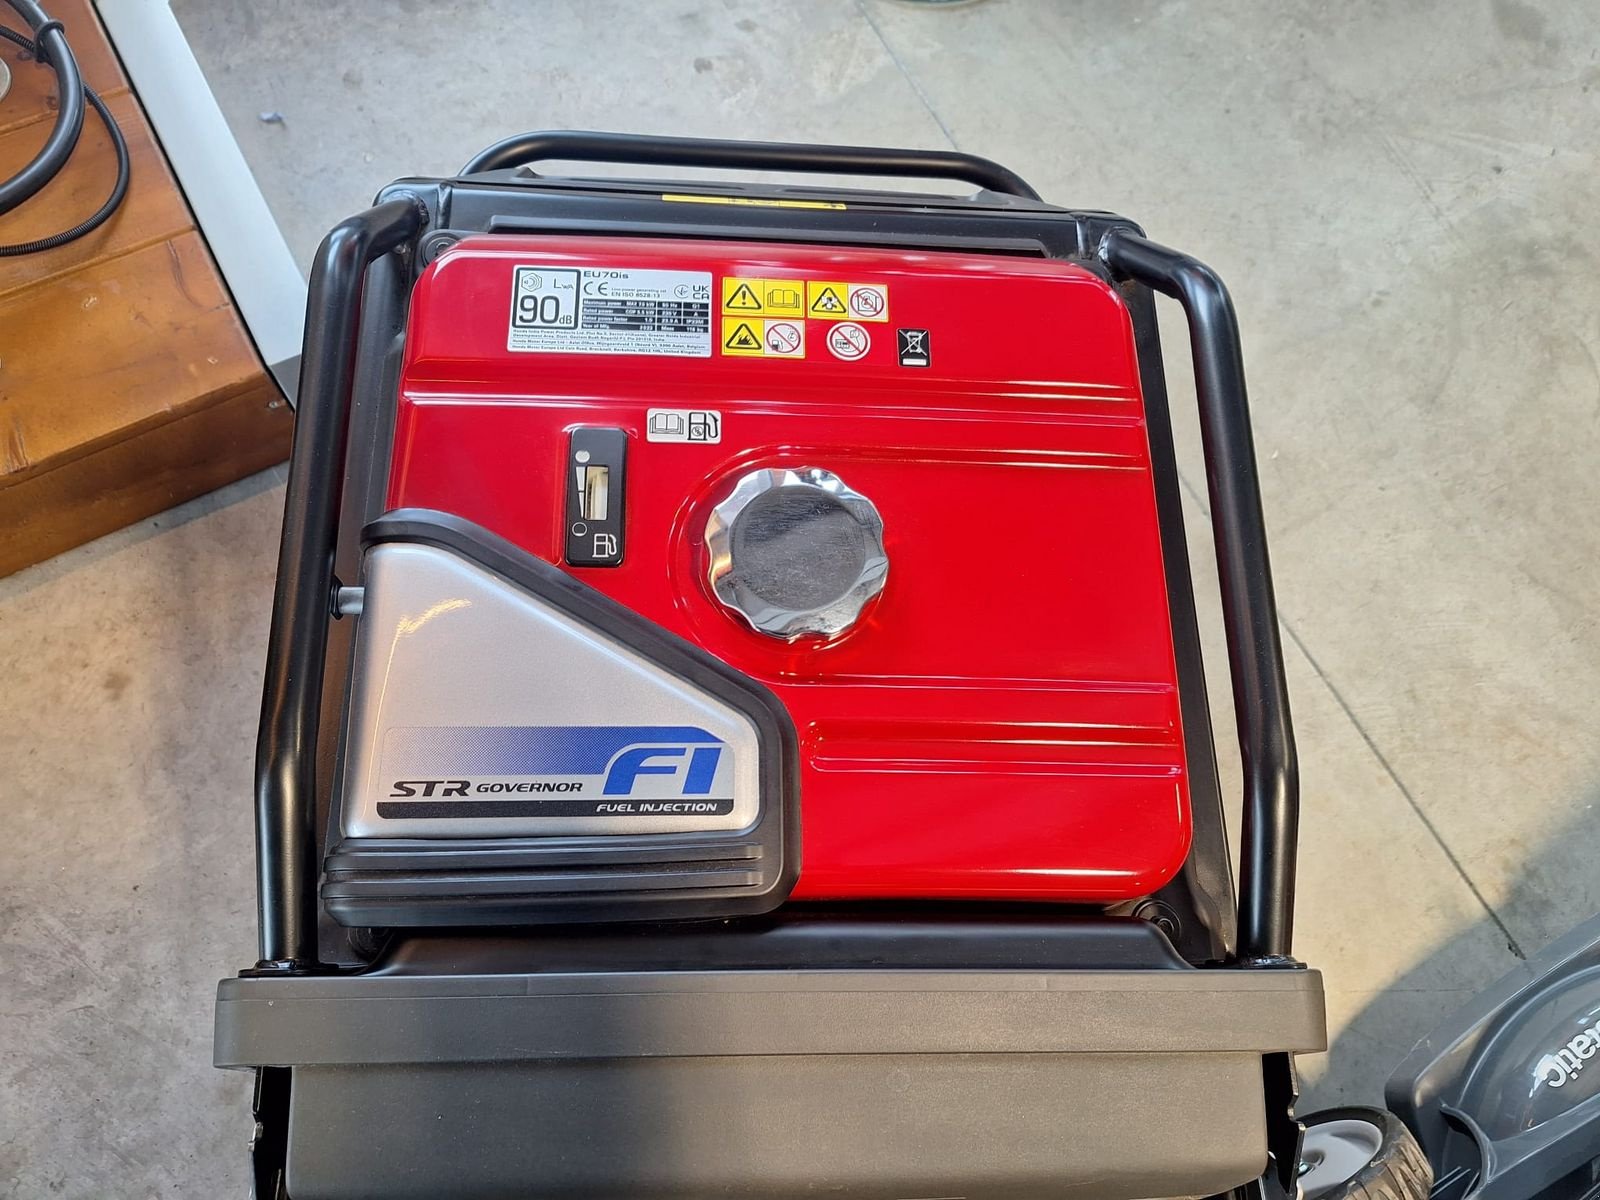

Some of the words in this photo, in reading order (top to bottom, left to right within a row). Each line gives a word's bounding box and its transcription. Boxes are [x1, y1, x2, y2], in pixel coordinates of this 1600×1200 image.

[583, 271, 629, 279] EU70is
[519, 295, 560, 324] 90
[559, 315, 573, 325] dB
[602, 747, 722, 795] FI
[389, 780, 471, 798] STR
[476, 782, 584, 793] GOVERNOR
[596, 803, 636, 813] FUEL
[639, 803, 718, 812] INJECTION
